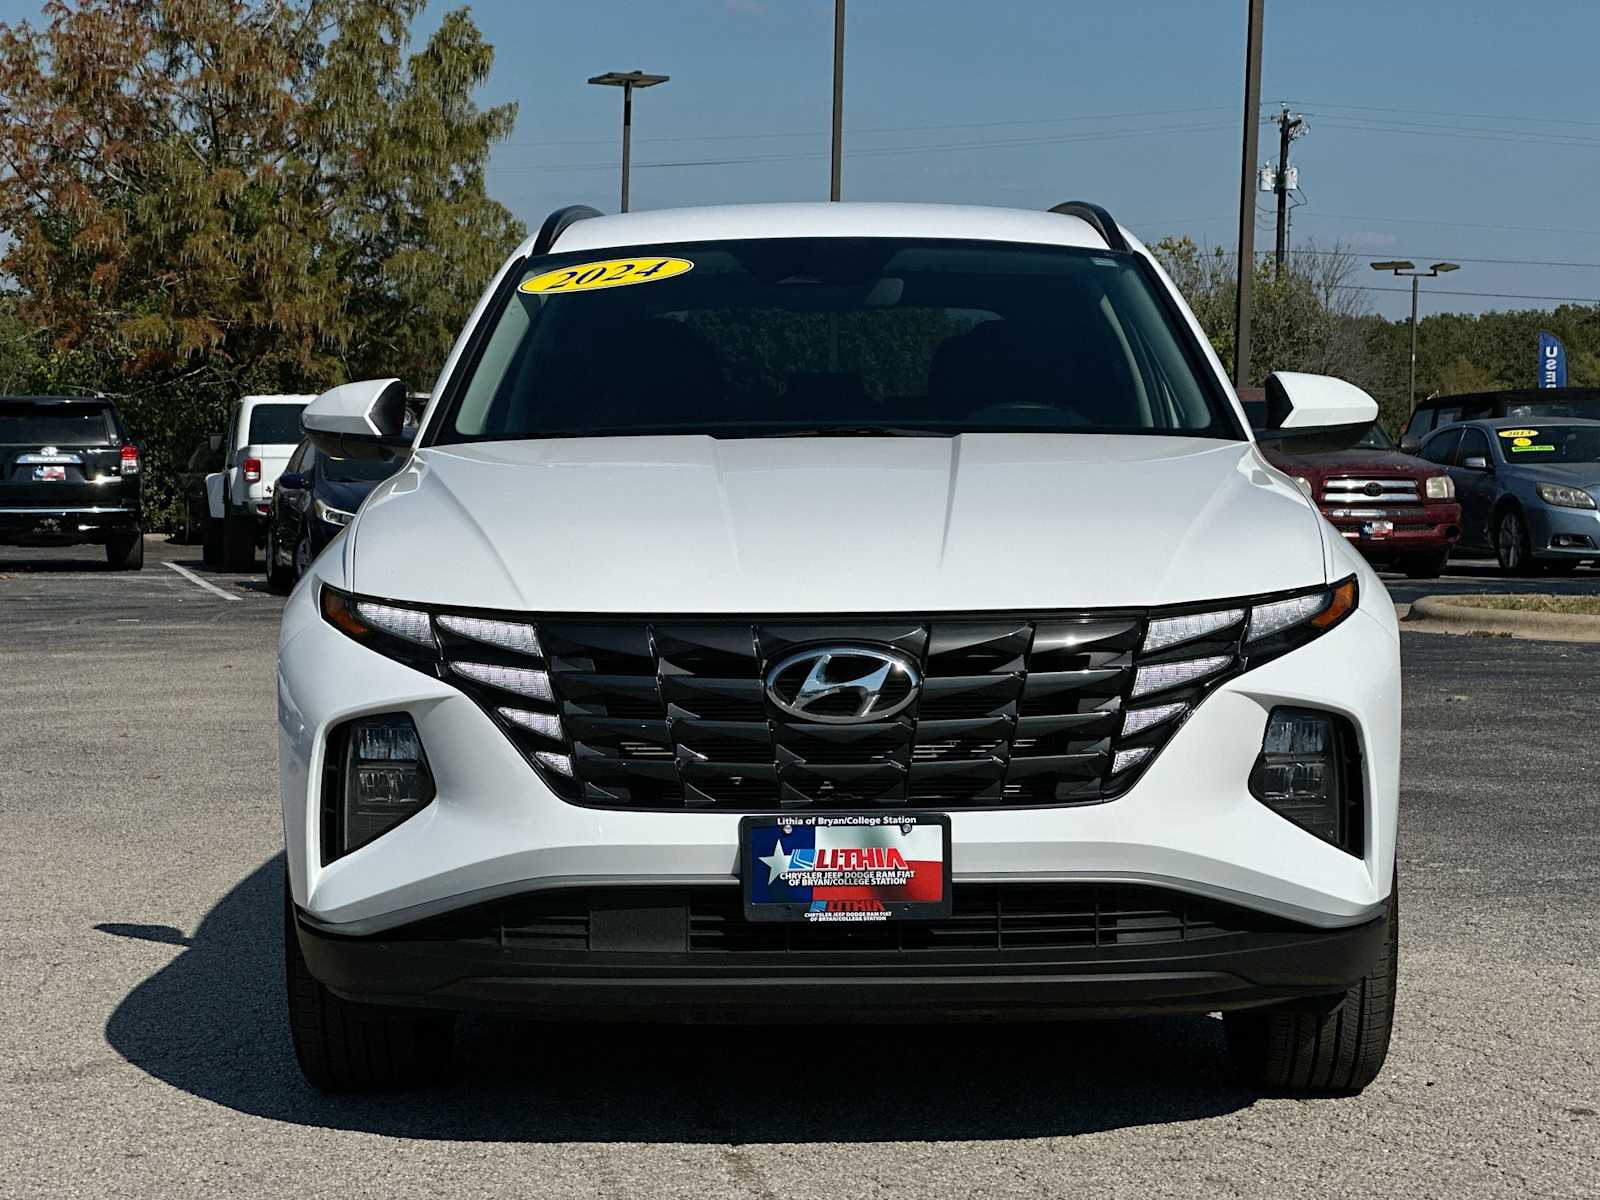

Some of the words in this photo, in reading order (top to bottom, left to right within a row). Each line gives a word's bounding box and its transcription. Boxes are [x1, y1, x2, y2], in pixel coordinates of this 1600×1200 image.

[546, 260, 669, 290] 2024
[777, 817, 803, 825] Lithia
[818, 816, 881, 826] Bryan/College
[883, 816, 916, 824] Station
[815, 848, 908, 870] LITHIA
[779, 872, 823, 880] CHRYSLER
[824, 871, 843, 879] JEEP
[844, 871, 875, 879] DODGE
[876, 871, 896, 879] RAM
[897, 870, 915, 878] FIAT
[788, 878, 800, 886] OF
[802, 878, 870, 886] BRYAN/COLLEGE
[827, 899, 886, 912] LITHIA
